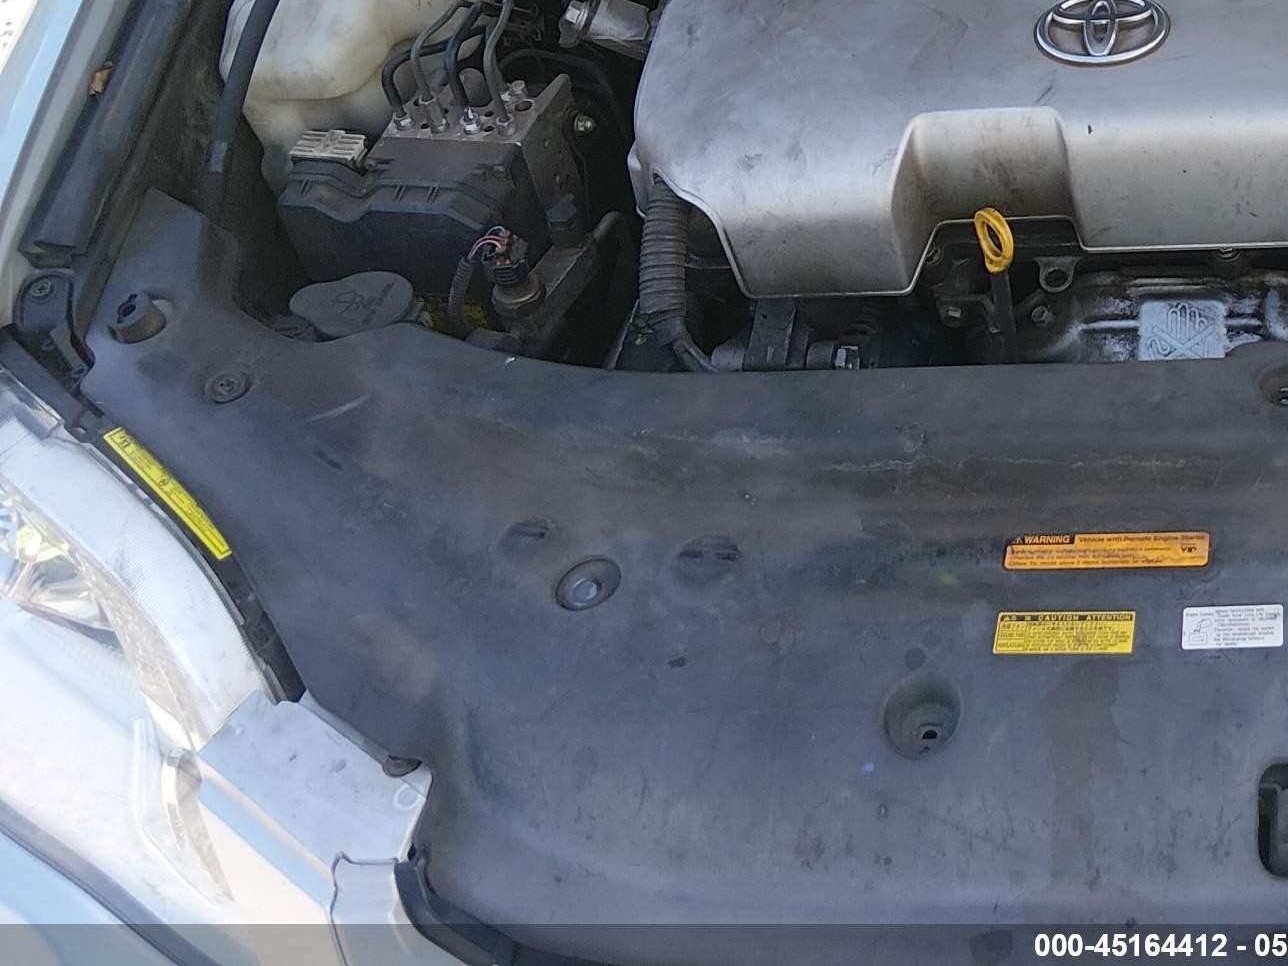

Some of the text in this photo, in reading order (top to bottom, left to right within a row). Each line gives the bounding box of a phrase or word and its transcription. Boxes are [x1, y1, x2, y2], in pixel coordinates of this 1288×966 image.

[1024, 535, 1071, 545] WARNING
[1038, 614, 1080, 622] CAUTION
[1085, 613, 1132, 621] ATTENTION
